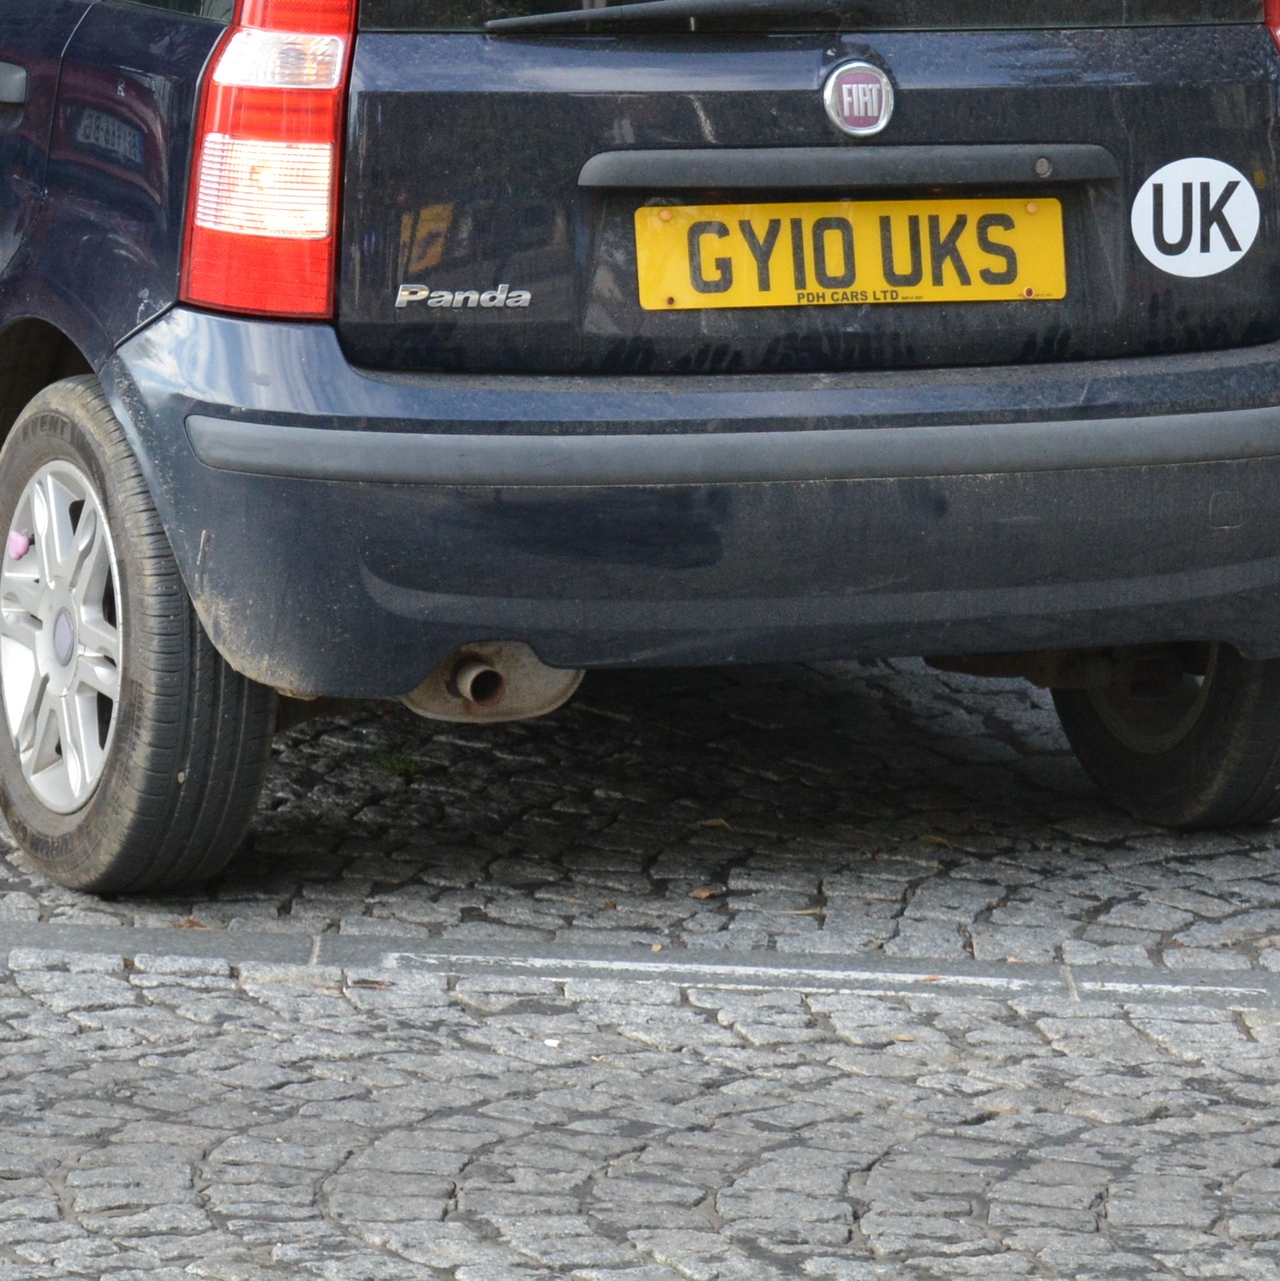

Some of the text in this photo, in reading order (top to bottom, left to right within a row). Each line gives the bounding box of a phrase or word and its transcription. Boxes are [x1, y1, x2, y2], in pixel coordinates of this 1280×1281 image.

[842, 83, 880, 117] FIAT
[1151, 179, 1243, 255] UK
[686, 212, 1018, 292] GY10 UKS
[394, 282, 532, 310] Panda
[797, 291, 826, 303] PDH
[831, 290, 868, 302] CARS
[873, 290, 899, 301] LTD
